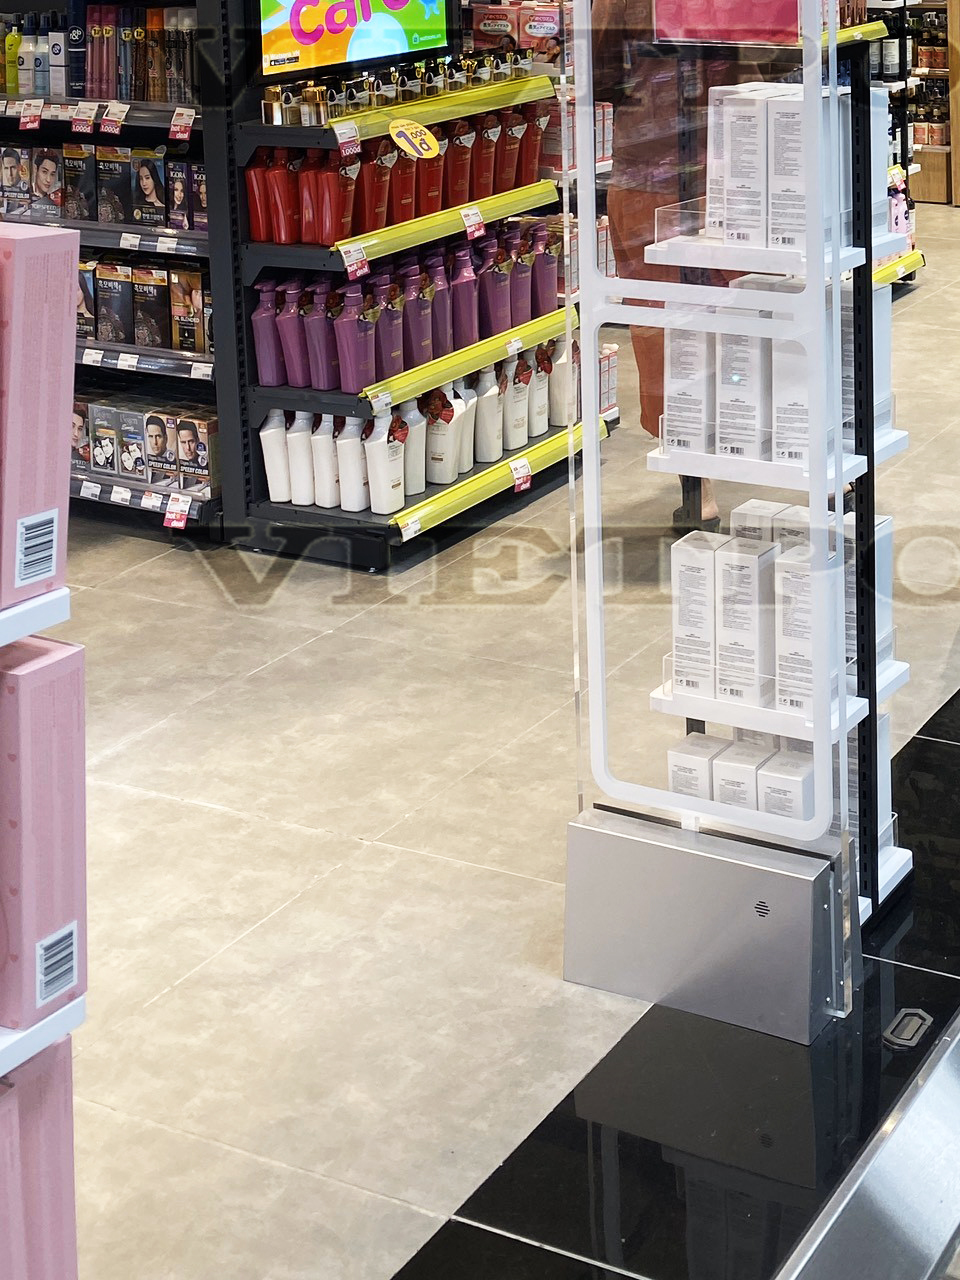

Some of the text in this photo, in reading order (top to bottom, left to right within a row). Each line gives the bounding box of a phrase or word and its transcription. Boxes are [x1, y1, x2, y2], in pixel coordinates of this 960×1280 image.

[170, 171, 186, 179] IGORA
[347, 264, 357, 272] hot
[356, 267, 368, 276] deal
[149, 462, 162, 470] SPEEDY
[180, 466, 208, 475] SPEEDY COLOR
